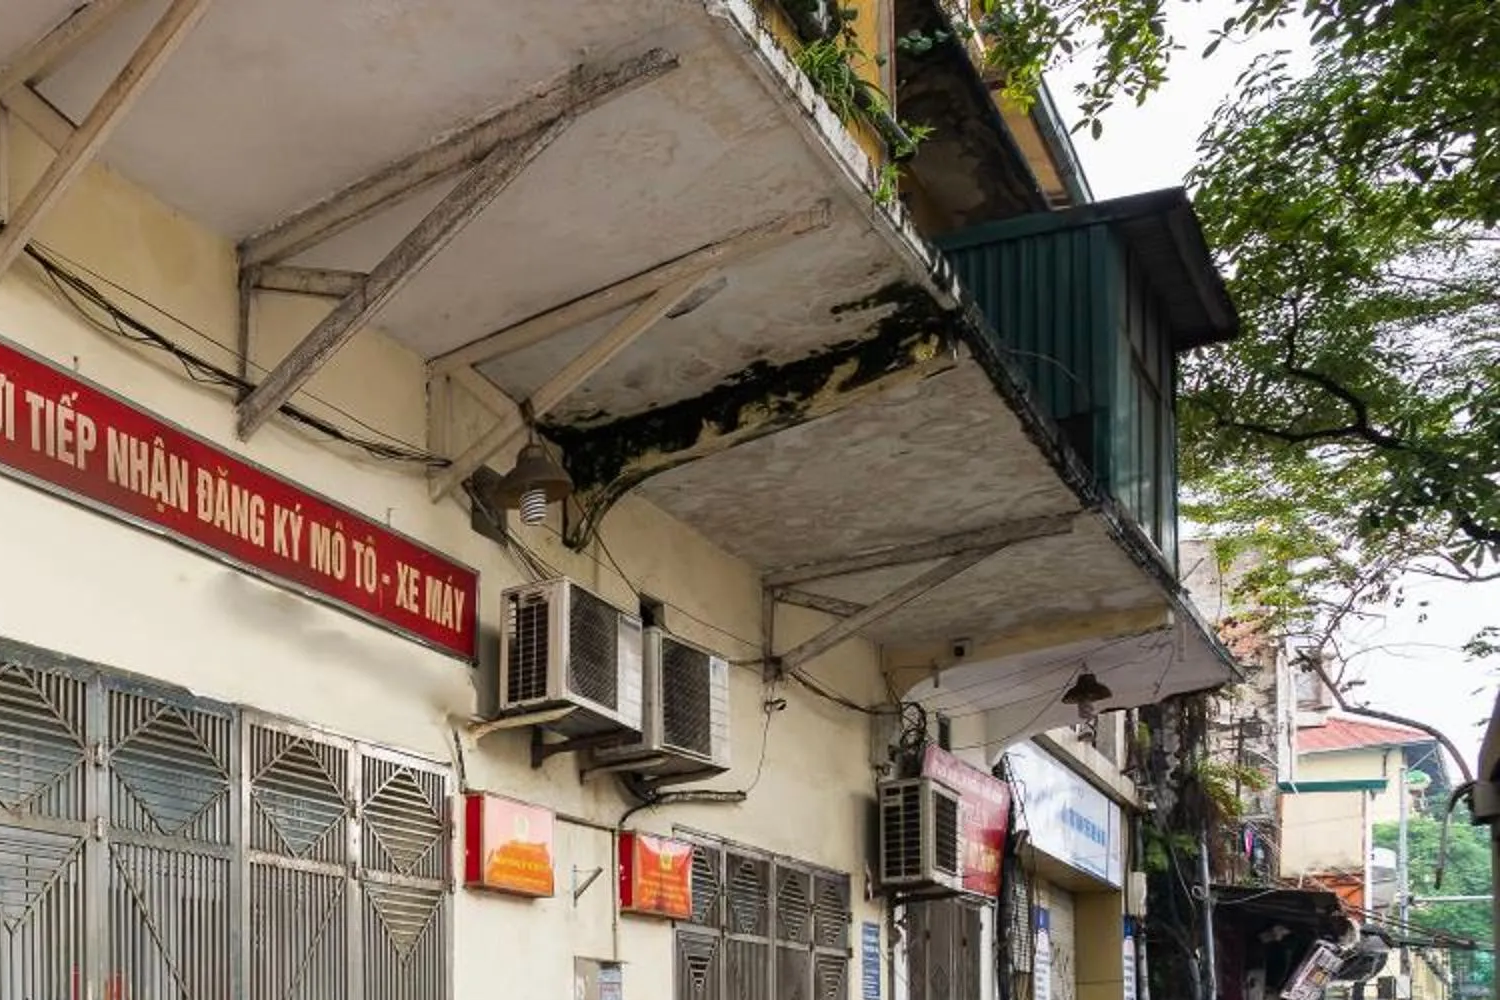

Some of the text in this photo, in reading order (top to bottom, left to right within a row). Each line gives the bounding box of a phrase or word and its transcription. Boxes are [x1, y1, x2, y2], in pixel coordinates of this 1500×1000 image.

[25, 391, 97, 471] TIẾP
[106, 435, 190, 514] NHẬN
[195, 465, 266, 548] ĐĂNG
[272, 503, 304, 563] KÝ
[309, 519, 347, 582] MÔ
[352, 535, 378, 594] TÔ
[395, 560, 420, 615] XE
[424, 574, 466, 633] MÁY
